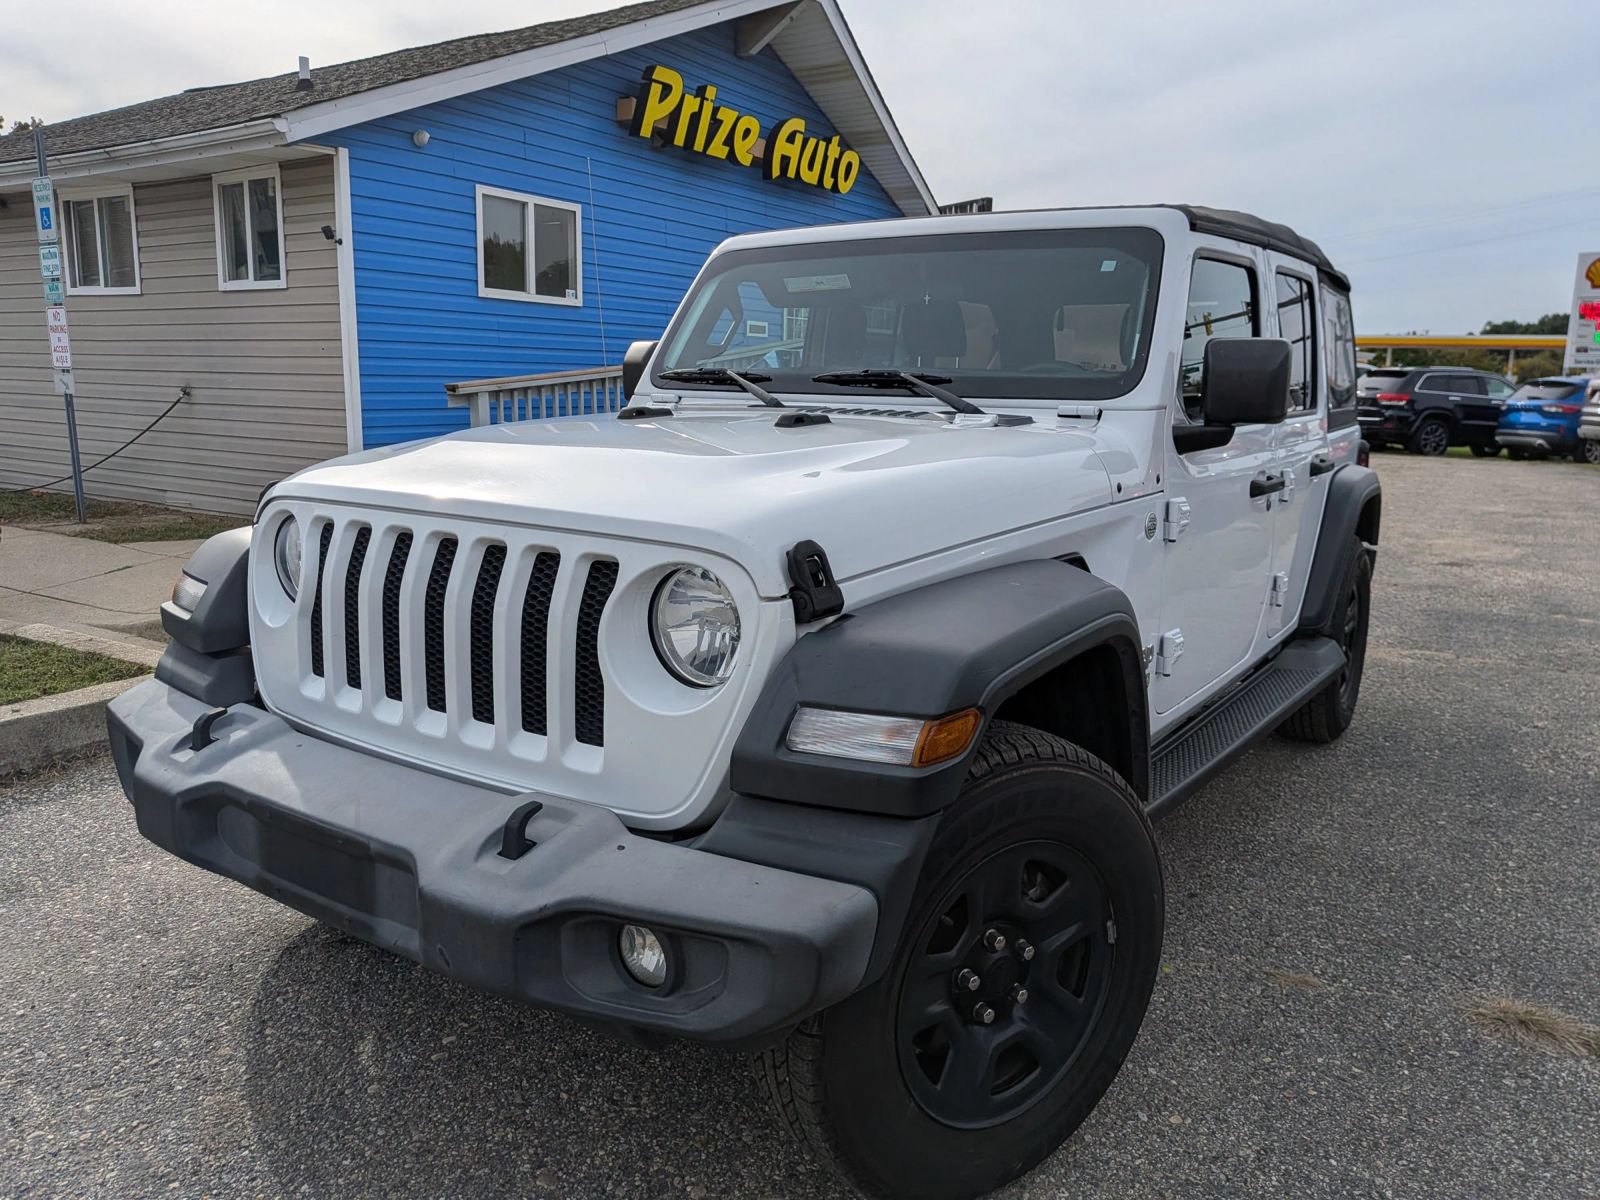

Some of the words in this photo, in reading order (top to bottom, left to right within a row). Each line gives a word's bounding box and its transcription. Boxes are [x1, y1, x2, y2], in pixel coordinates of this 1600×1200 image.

[639, 65, 760, 167] Prize
[772, 118, 860, 194] Auto
[53, 311, 61, 321] NO
[49, 324, 67, 334] PARKING
[53, 345, 69, 353] ACCESS
[56, 355, 69, 364] AISLE
